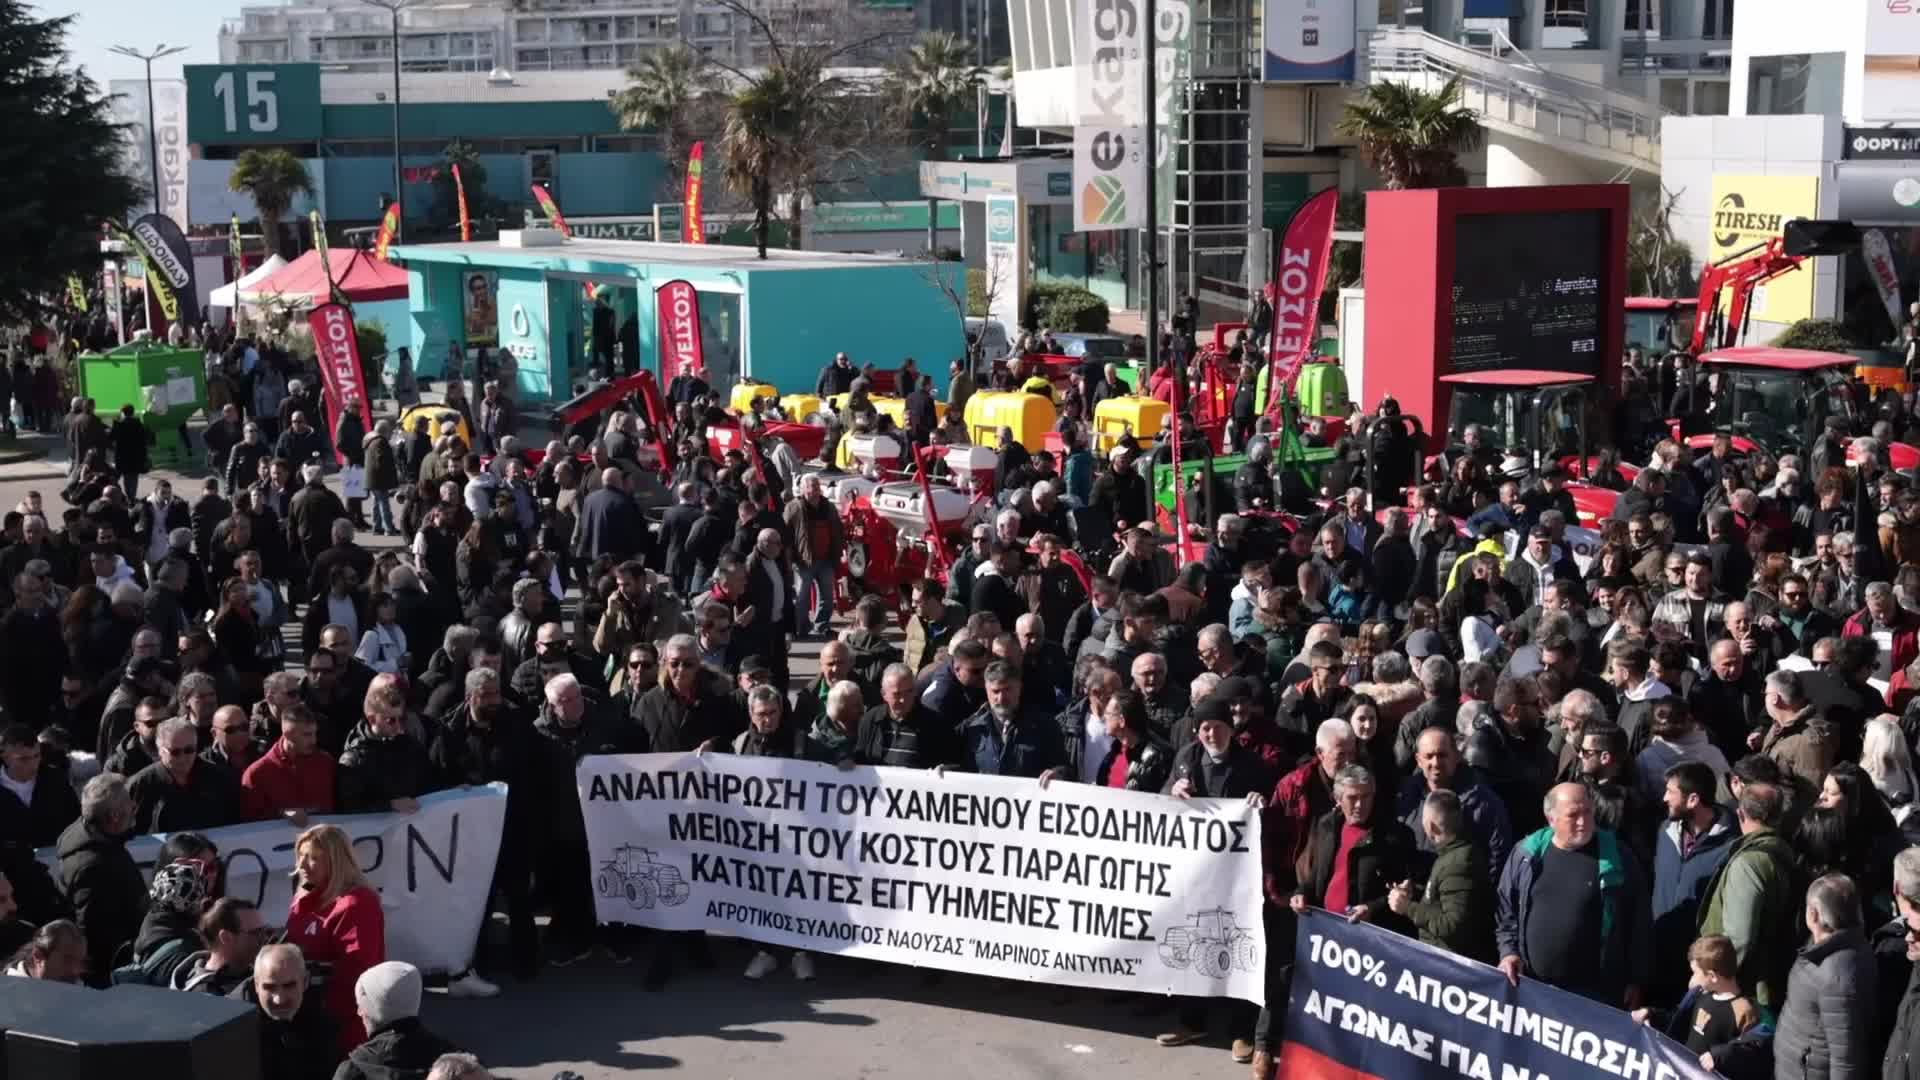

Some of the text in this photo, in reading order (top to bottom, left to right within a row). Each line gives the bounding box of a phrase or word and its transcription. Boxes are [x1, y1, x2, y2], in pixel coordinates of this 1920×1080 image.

[214, 71, 278, 132] 15
[1714, 211, 1806, 231] TIRESH
[1274, 247, 1311, 376] ΛΕΤΣΟΣ
[589, 770, 1250, 853] ΑΝΑΠΛΗΡΩΣΗ ΤΟΥ ΧΑΜΕΝΟΥ ΕΙΣΟΔΗΜΑΤΟΣ
[669, 812, 1171, 897] ΜΕΙΩΣΗ ΤΟΥ ΚΟΣΤΟΥΣ ΠΑΡΑΓΩΓΗΣ
[691, 852, 1155, 942] ΚΑΤΩΤΑΤΕΣ ΕΓΓΥΗΜΕΝΕΣ ΤΙΜΕΣ
[706, 900, 793, 932] ΑΓΡΟΤΙΚΟΣ
[796, 919, 884, 945] ΣΥΛΛΟΓΟΣ
[887, 928, 965, 956] ΝΑΟΥΣΑΣ
[1304, 990, 1437, 1061] ΑΓΩΝΑΣ
[1440, 1039, 1493, 1080] ΓΙΑ
[1310, 935, 1650, 1080] 100% ΑΠΟΖΗΜΕΙΩΣΗ
